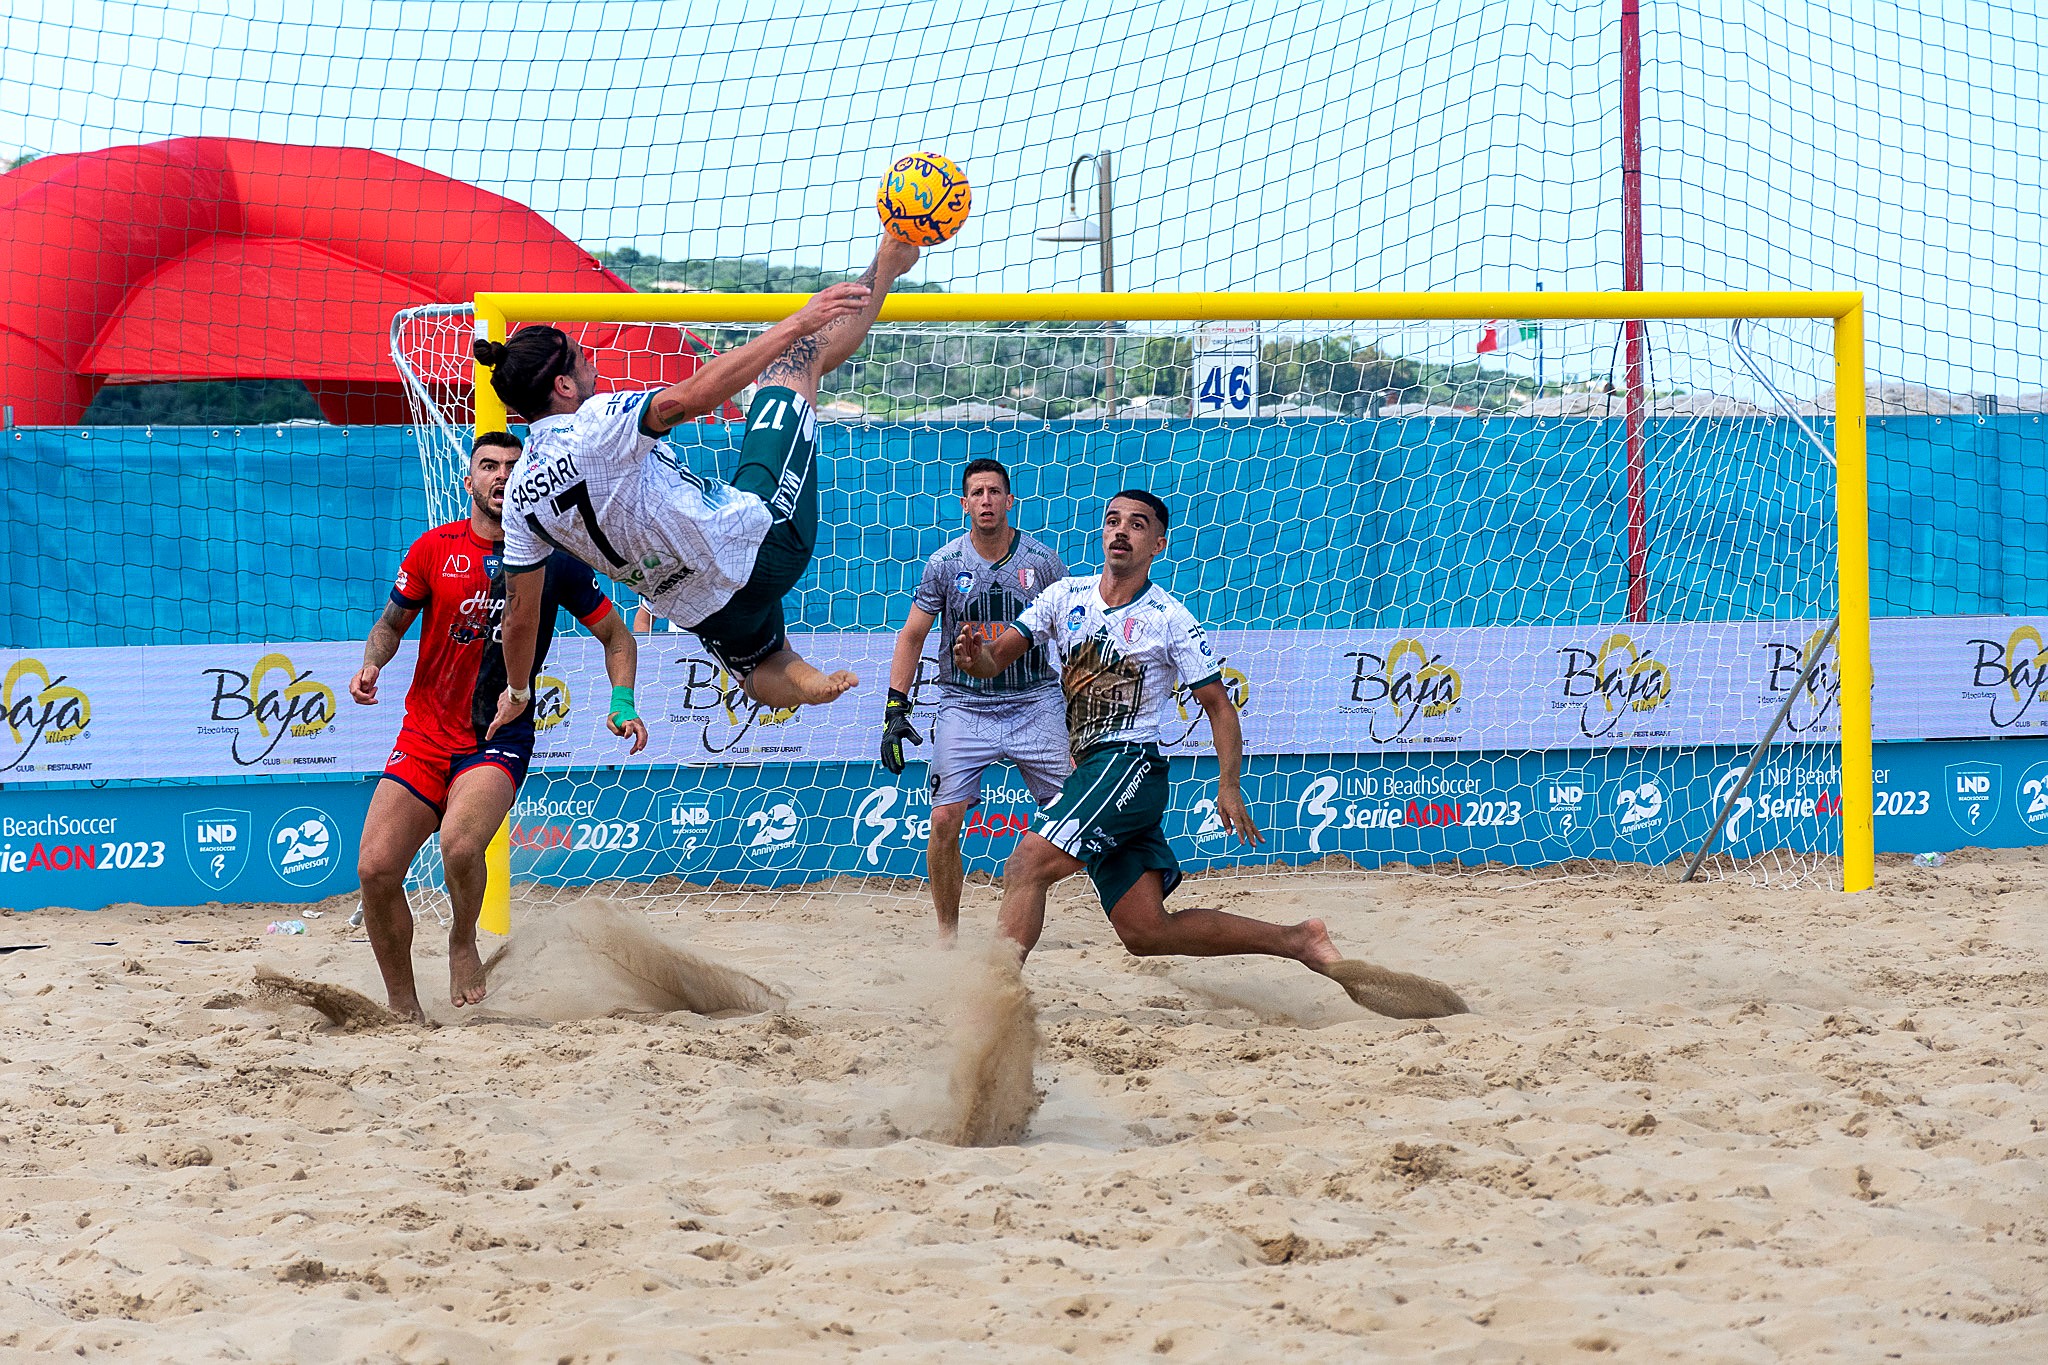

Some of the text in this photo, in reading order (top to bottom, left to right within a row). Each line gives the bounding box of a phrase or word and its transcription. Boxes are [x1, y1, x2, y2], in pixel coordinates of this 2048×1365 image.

[1200, 365, 1251, 410] 46
[511, 453, 580, 512] SASSARI
[1027, 547, 1049, 559] MILANO
[459, 590, 506, 618] Hap
[1115, 761, 1152, 812] PRIMATO
[1346, 774, 1482, 796] LND BeachSoccer
[1760, 768, 1791, 786] LND
[1956, 775, 1991, 795] LND
[1549, 786, 1583, 804] LND
[1872, 790, 1931, 816] 2023
[671, 806, 710, 827] LND
[1462, 800, 1522, 827] 2023
[3, 813, 118, 837] BeachSoccer
[197, 823, 237, 845] LND
[1621, 817, 1663, 834] Anniversary
[573, 823, 640, 850] 2023
[97, 840, 166, 870] 2023
[751, 839, 797, 858] Anniversary
[282, 856, 330, 876] Anniversary
